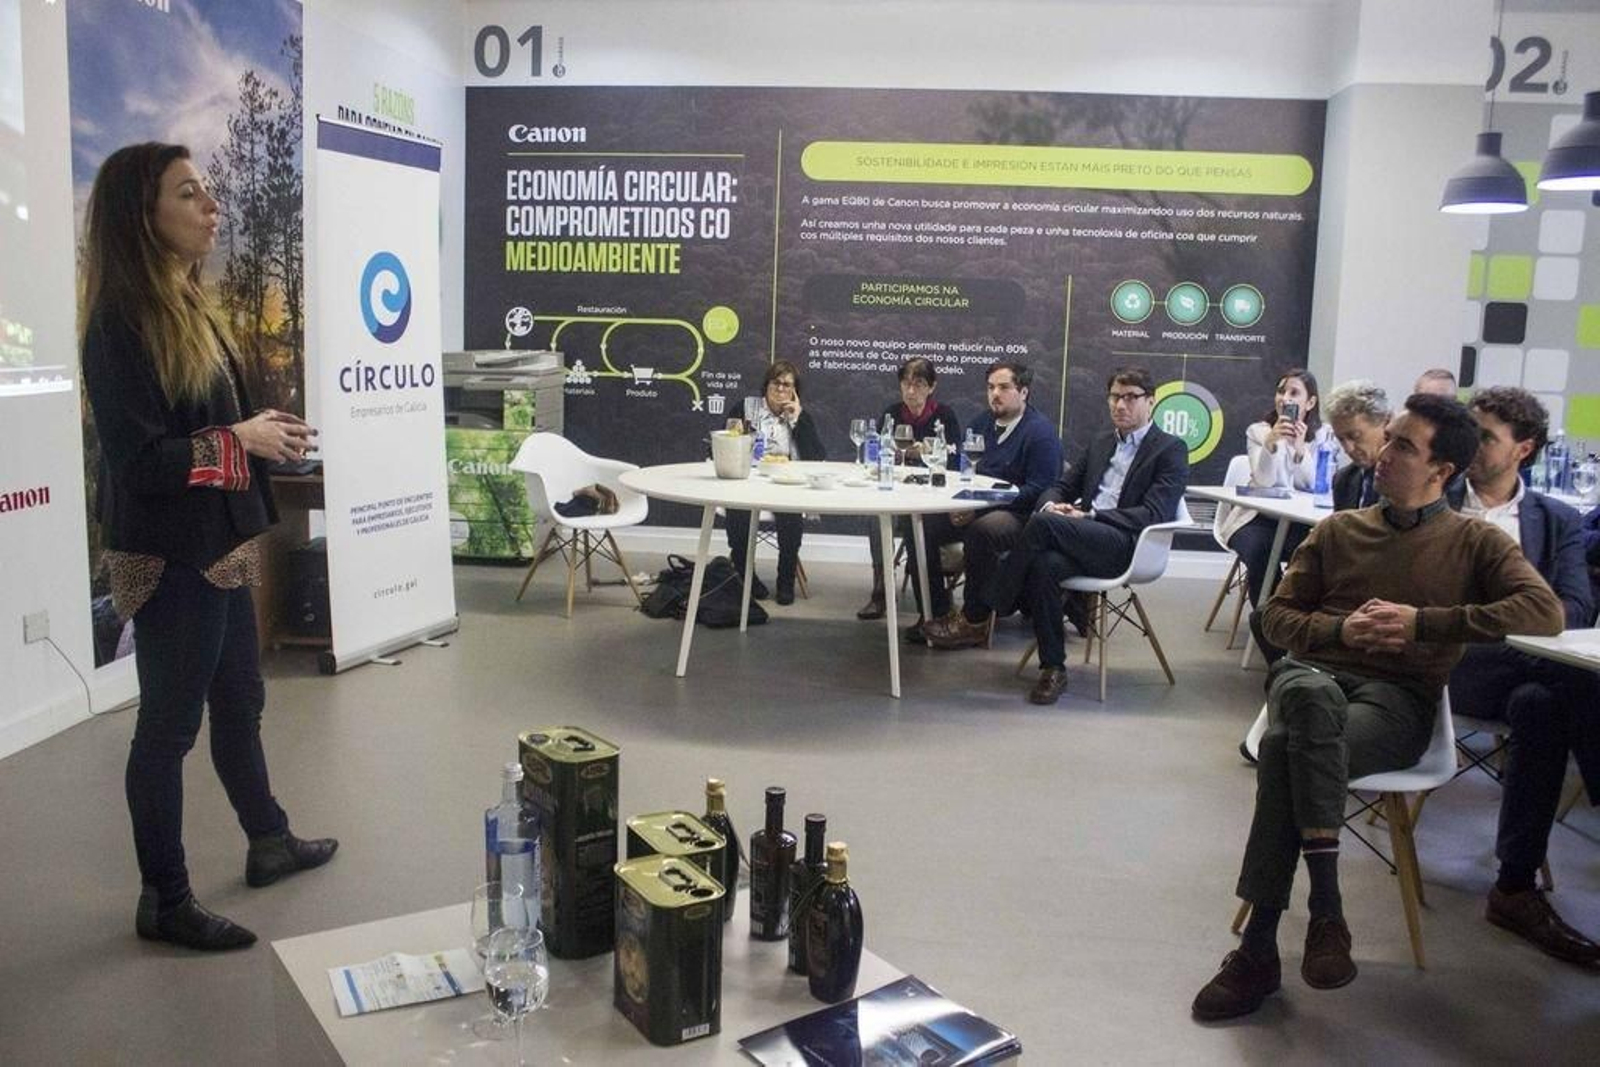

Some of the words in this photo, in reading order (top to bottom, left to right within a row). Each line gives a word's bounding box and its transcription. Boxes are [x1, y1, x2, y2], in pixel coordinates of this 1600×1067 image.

[474, 24, 542, 78] 01
[508, 124, 586, 143] Canon
[856, 155, 959, 170] SOSTENIBILIDADE
[963, 158, 969, 169] E
[1081, 163, 1111, 173] MAIS
[1155, 165, 1175, 176] DO
[1177, 166, 1201, 177] QUE
[1205, 168, 1252, 179] PENSAS
[507, 165, 618, 201] ECONOMÍA
[624, 170, 738, 203] CIRCULAR:
[801, 195, 810, 205] A
[811, 196, 839, 207] gama
[872, 197, 885, 207] de
[887, 197, 919, 207] Canon
[921, 198, 951, 209] busca
[952, 199, 1001, 211] promover
[1002, 202, 1010, 211] a
[1062, 202, 1100, 214] circular
[1175, 207, 1195, 218] uso
[1196, 207, 1216, 219] dos
[1217, 210, 1260, 220] recursos
[506, 205, 695, 239] COMPROMETIDOS
[699, 207, 731, 240] CO
[801, 218, 817, 228] Así
[818, 220, 860, 230] creamos
[861, 221, 887, 231] unha
[888, 222, 912, 232] nova
[914, 221, 957, 233] utilidade
[959, 224, 982, 235] para
[983, 224, 1009, 235] cada
[1010, 226, 1034, 237] peza
[1036, 227, 1043, 236] e
[1045, 226, 1070, 237] unha
[1125, 228, 1139, 239] de
[1140, 229, 1175, 240] oficina
[1176, 231, 1195, 241] coa
[1196, 232, 1217, 244] que
[1218, 231, 1259, 245] cumprir
[800, 230, 818, 241] cos
[819, 230, 864, 243] múltiples
[866, 231, 914, 244] requisitos
[915, 233, 934, 244] dos
[936, 234, 965, 245] nosos
[966, 235, 1008, 246] clientes.
[505, 241, 681, 274] MEDIOAMBIENTE
[861, 282, 940, 295] PARTICIPAMOS
[942, 286, 960, 296] NA
[852, 294, 912, 306] ECONOMÍA
[914, 297, 970, 309] CIRCULAR
[809, 336, 819, 346] O
[820, 338, 845, 348] noso
[846, 339, 871, 349] novo
[872, 340, 907, 351] equipo
[908, 341, 946, 352] permite
[948, 342, 983, 354] reducir
[985, 343, 1004, 353] nun
[1005, 343, 1029, 354] 80%
[1111, 329, 1150, 339] MATERIAL
[1215, 333, 1266, 343] TRANSPORTE
[808, 348, 820, 358] as
[866, 350, 880, 360] de
[945, 354, 959, 363] ao
[339, 359, 435, 393] CÍRCULO
[701, 370, 714, 379] Fin
[808, 359, 821, 370] de
[823, 359, 877, 372] fabricación
[878, 362, 898, 373] dun
[934, 364, 965, 376] odelo.
[564, 388, 595, 397] ateriais
[625, 388, 658, 398] Produto
[706, 380, 723, 389] vida
[1162, 410, 1199, 438] 80%
[448, 458, 513, 476] Canon
